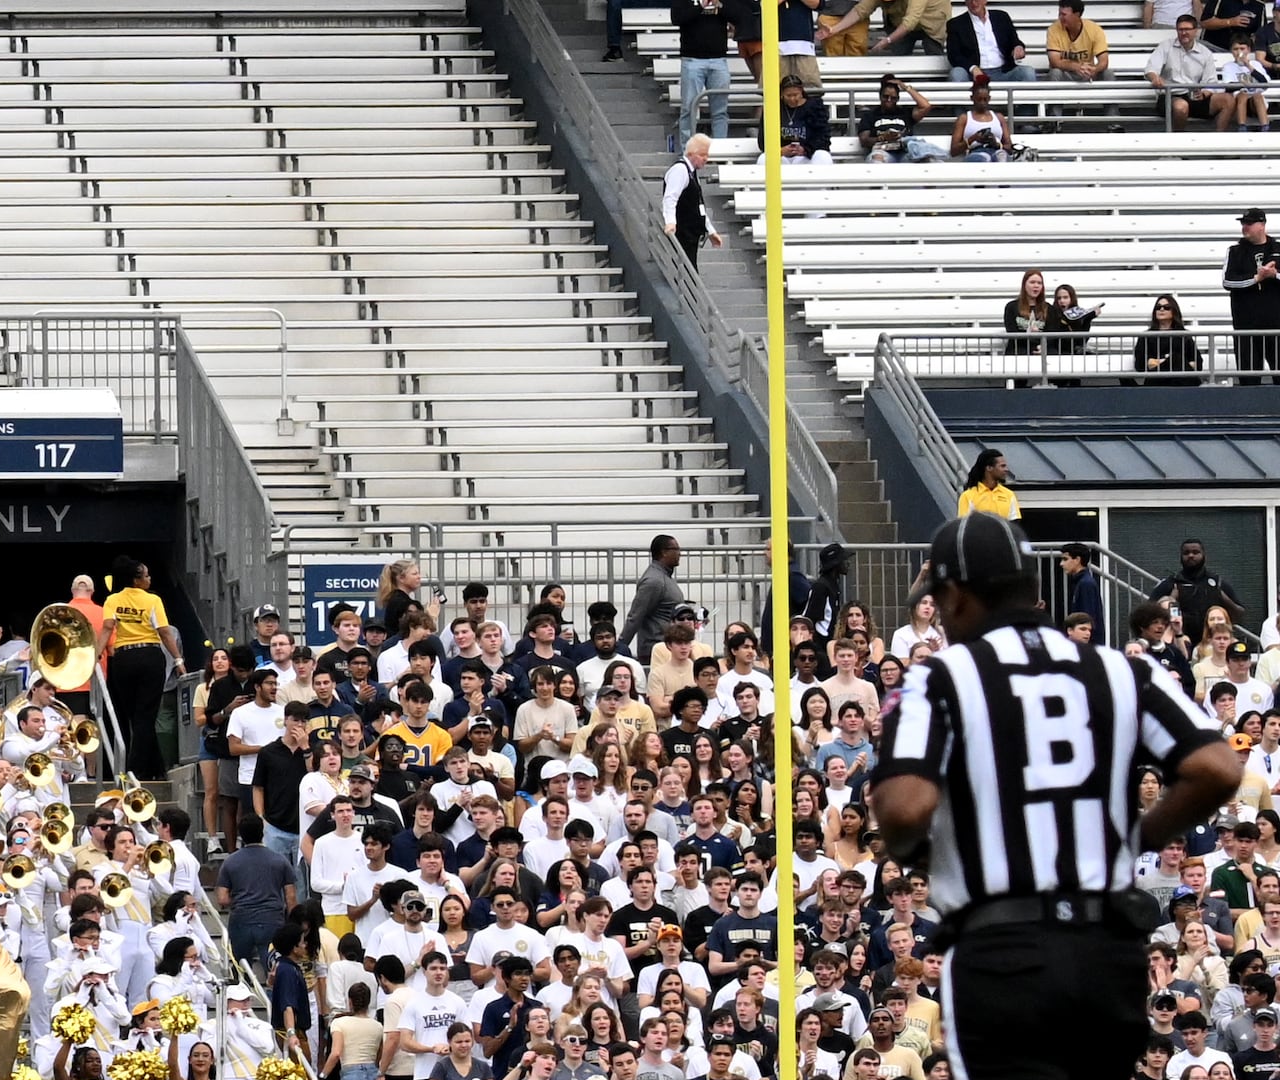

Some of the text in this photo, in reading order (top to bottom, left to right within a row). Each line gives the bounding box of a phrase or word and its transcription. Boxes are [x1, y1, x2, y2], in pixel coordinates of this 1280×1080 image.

[35, 443, 76, 468] 117
[325, 578, 379, 589] SECTION
[117, 606, 145, 616] BEST
[1009, 673, 1095, 791] B
[403, 745, 432, 764] 21
[422, 1015, 456, 1024] YELLOW
